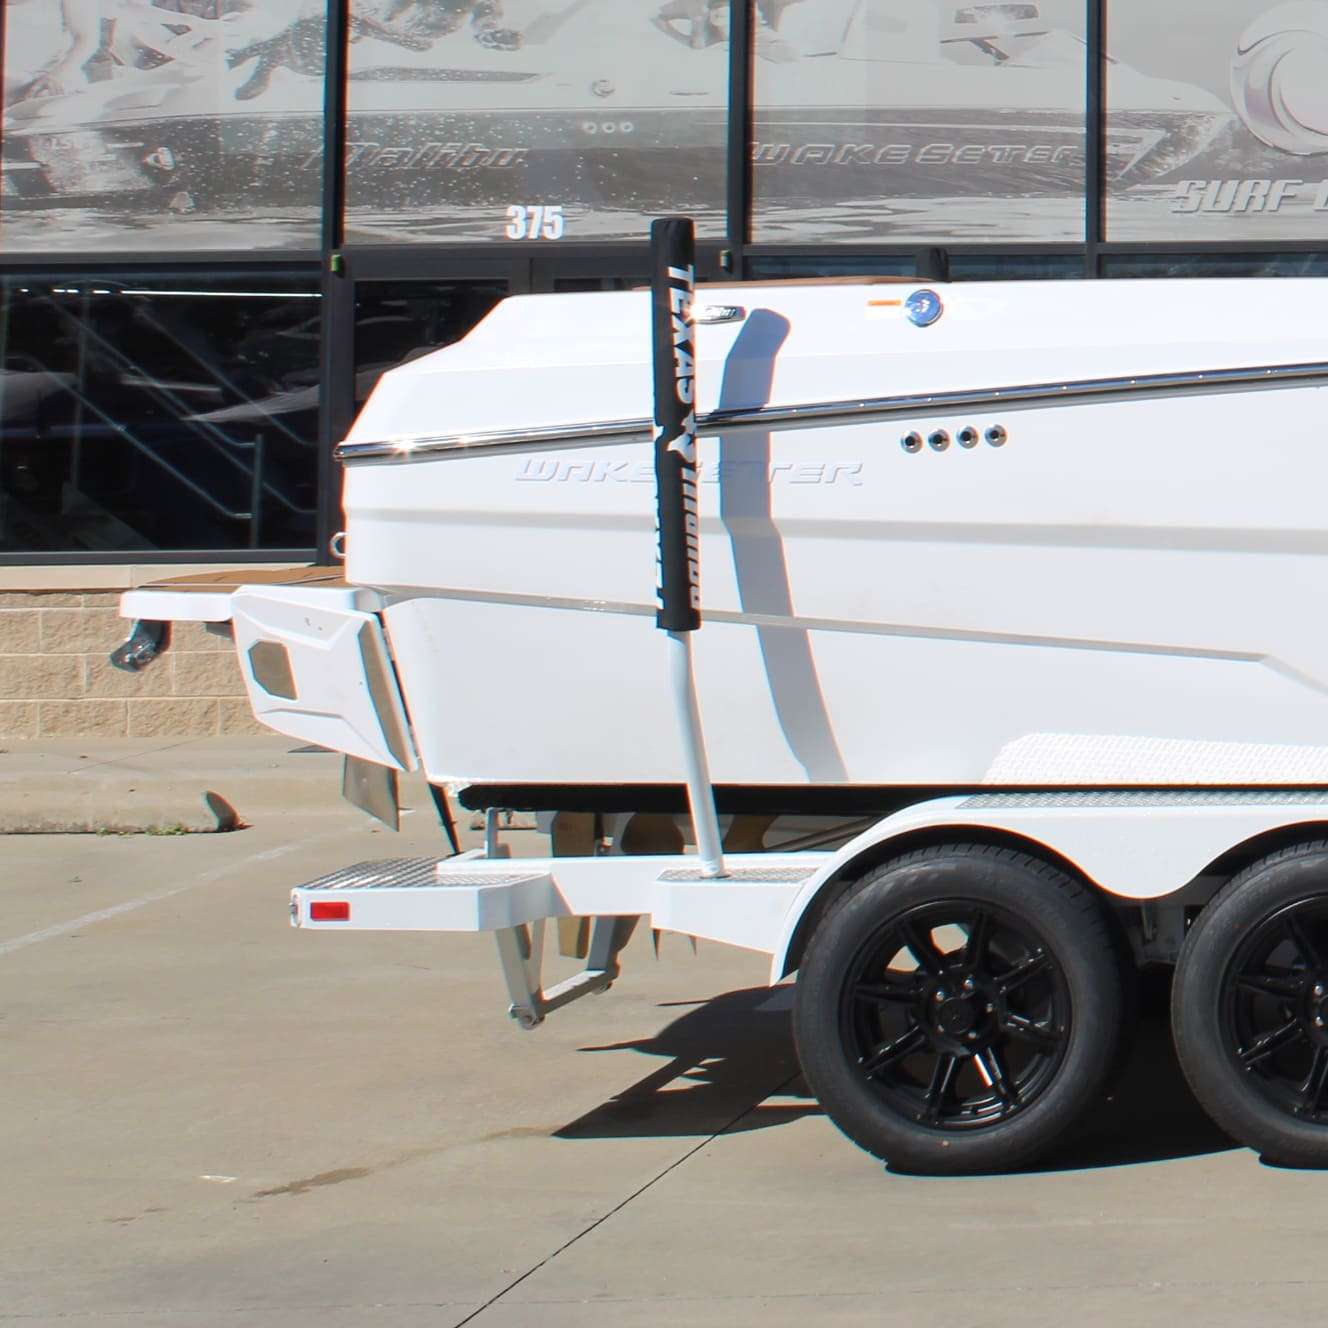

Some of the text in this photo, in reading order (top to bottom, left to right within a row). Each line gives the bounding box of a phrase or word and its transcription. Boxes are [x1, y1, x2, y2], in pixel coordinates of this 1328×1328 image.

[1171, 178, 1304, 214] SURF
[505, 204, 564, 241] 375
[513, 456, 864, 488] WAKEETER
